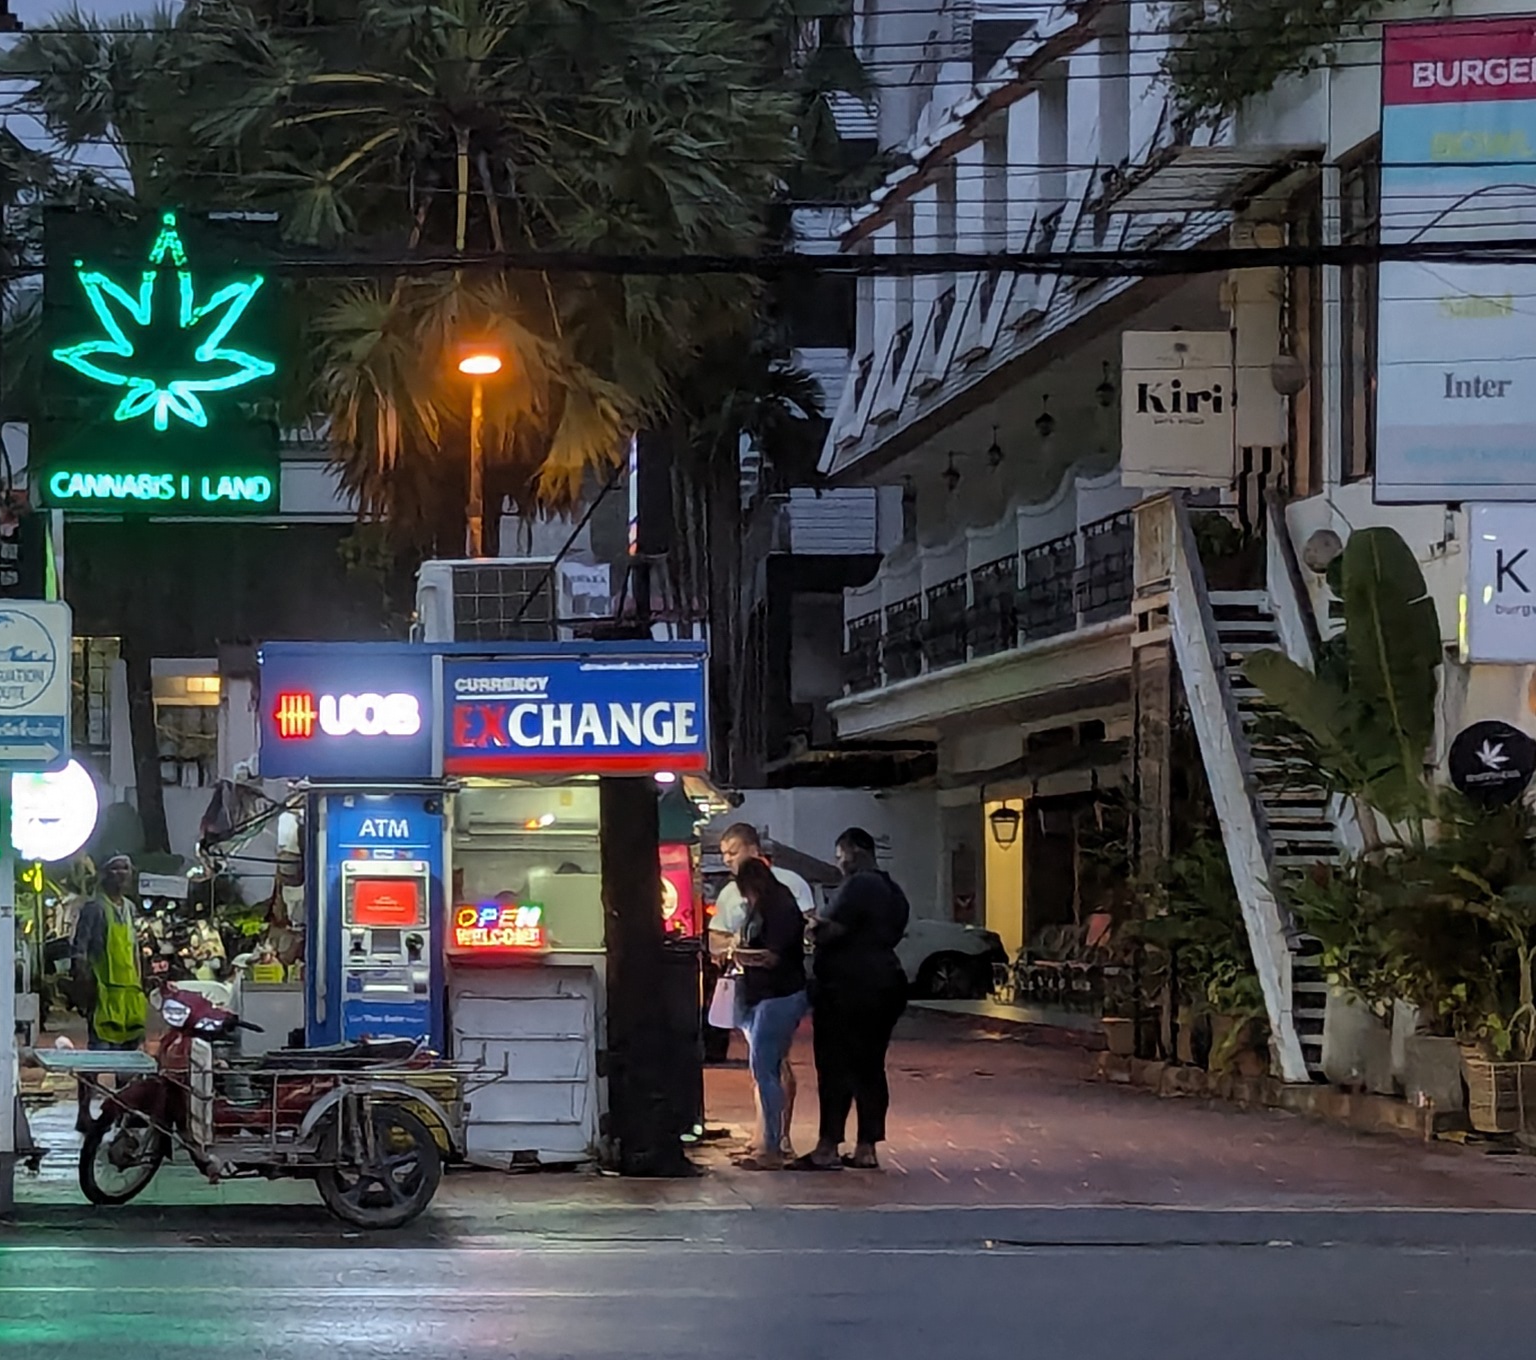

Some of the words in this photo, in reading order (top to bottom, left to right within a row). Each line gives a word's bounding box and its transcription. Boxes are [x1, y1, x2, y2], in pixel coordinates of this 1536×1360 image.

[1412, 57, 1536, 88] BURGE
[1135, 378, 1222, 414] Kiri
[1443, 372, 1512, 400] Inter
[49, 472, 175, 500] CANNABIS
[202, 475, 272, 502] LAND
[1496, 548, 1532, 594] K
[1495, 603, 1536, 618] burg
[454, 675, 549, 693] CURRENCY
[319, 692, 421, 736] UOB
[452, 702, 699, 748] EXCHANGE
[359, 819, 409, 839] ATM
[457, 906, 542, 928] OPEN
[455, 927, 541, 947] WELCOME
